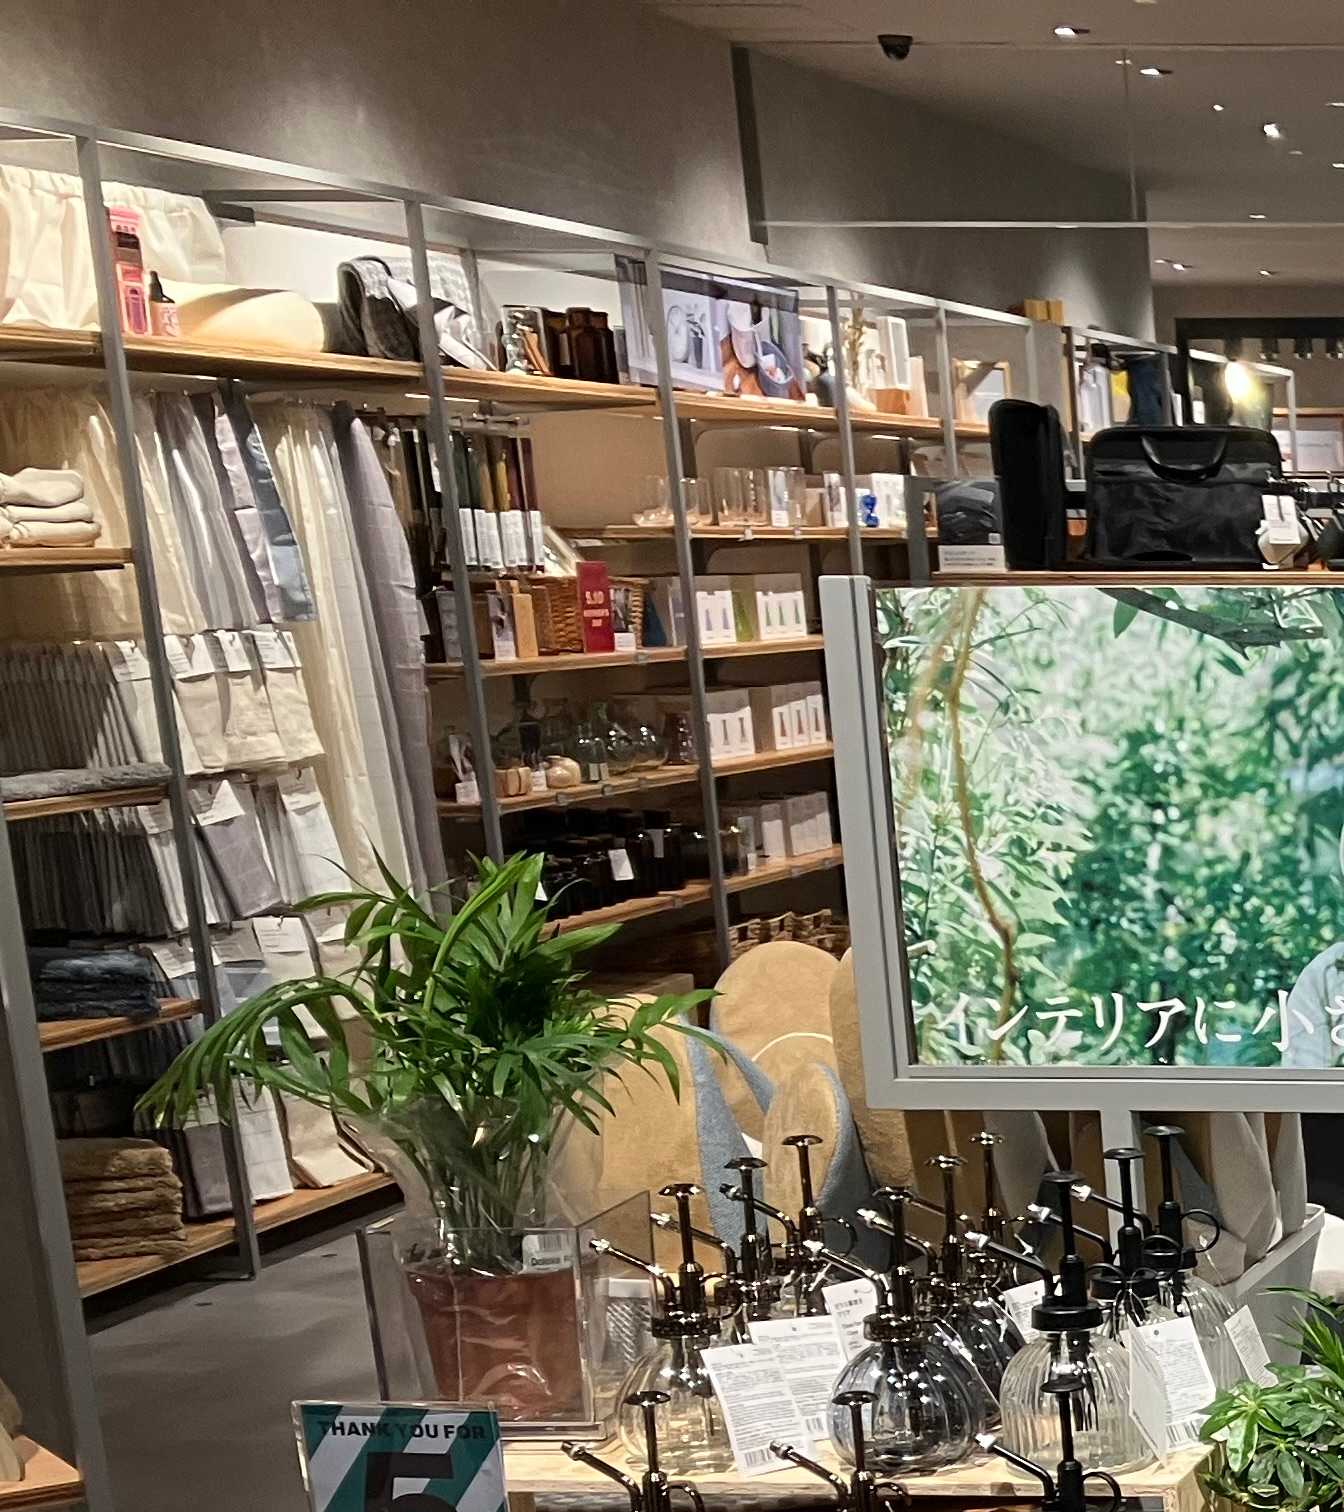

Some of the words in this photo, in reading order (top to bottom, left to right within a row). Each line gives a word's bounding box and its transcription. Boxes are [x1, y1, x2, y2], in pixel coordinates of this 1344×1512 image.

[318, 1421, 393, 1439] THANK
[397, 1423, 439, 1439] YOU
[444, 1424, 487, 1440] FOR
